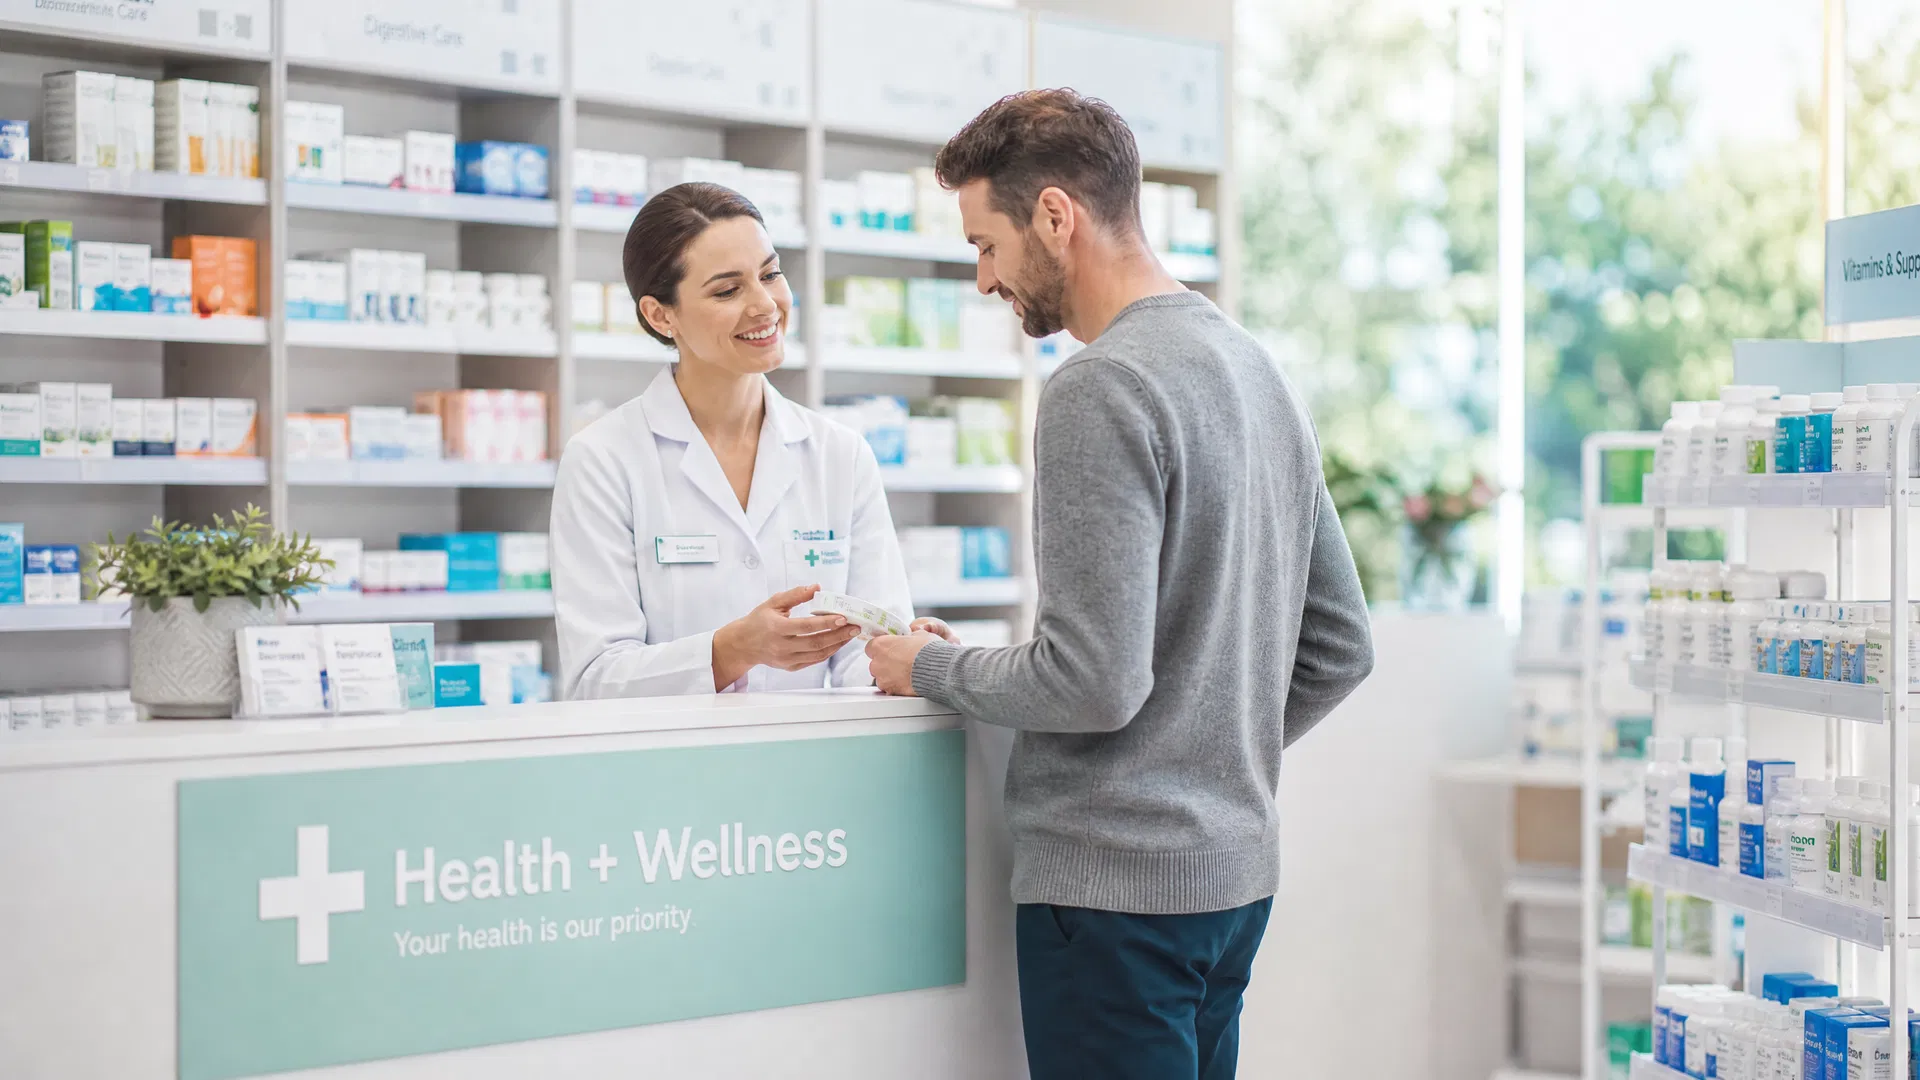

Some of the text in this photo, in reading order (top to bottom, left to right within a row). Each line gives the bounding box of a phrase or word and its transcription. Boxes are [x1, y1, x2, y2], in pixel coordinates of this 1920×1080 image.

[117, 4, 148, 21] Care
[1842, 256, 1884, 281] Vitamins
[1886, 252, 1893, 276] &
[395, 822, 848, 907] Health + Wellness
[393, 930, 451, 958] Your
[458, 918, 533, 951] health
[541, 916, 558, 942] is
[564, 916, 603, 939] our
